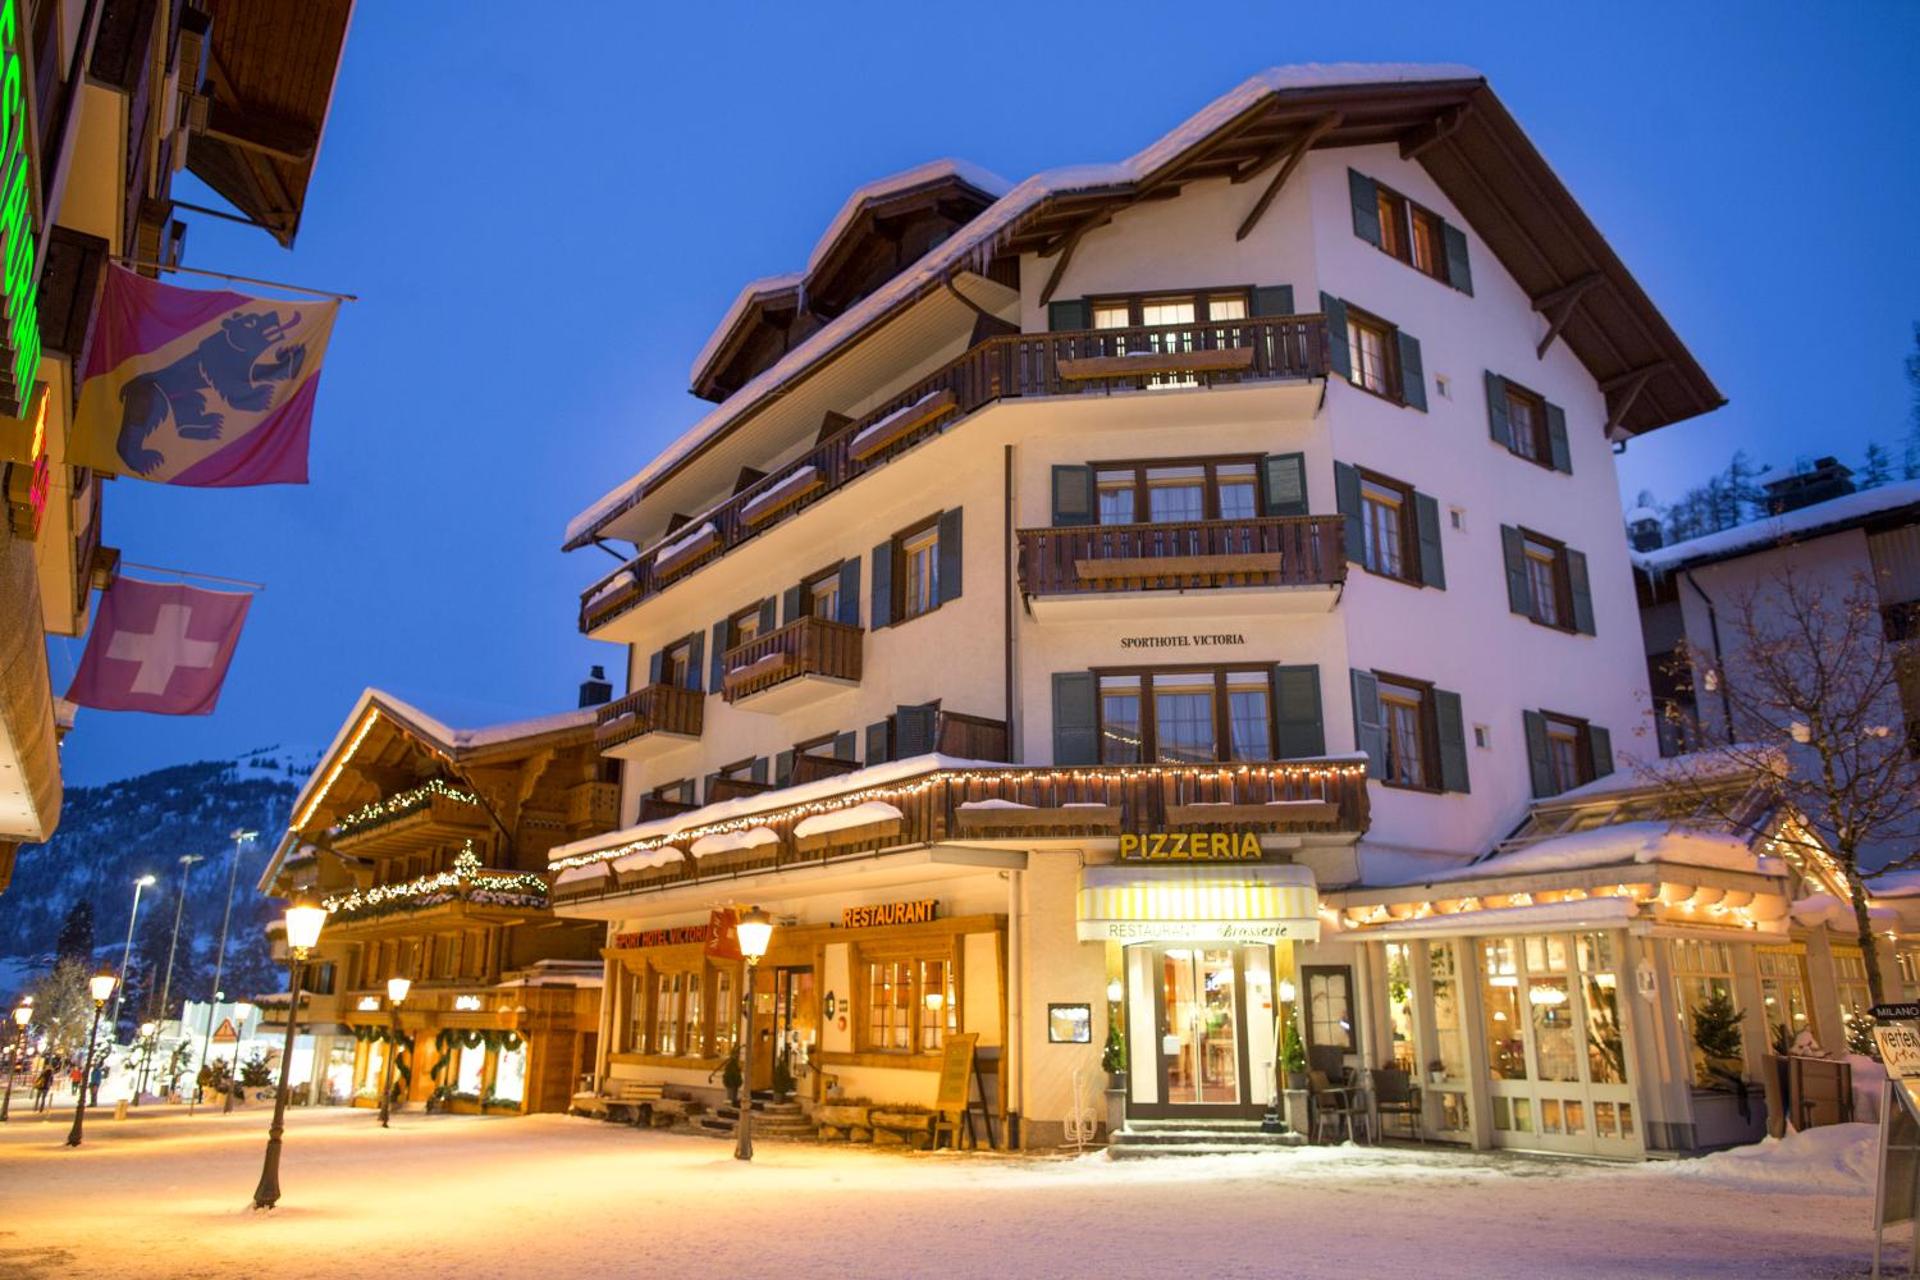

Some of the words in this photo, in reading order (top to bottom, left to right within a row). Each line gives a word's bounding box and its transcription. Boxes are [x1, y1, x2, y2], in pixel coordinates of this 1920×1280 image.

[1120, 635, 1191, 648] SPORTHOTEL
[1193, 633, 1245, 646] VICTORIA
[1120, 832, 1262, 858] PIZZERIA
[842, 899, 934, 928] RESTAURANT
[671, 924, 709, 944] VICTORI
[1876, 1006, 1919, 1017] MILANO
